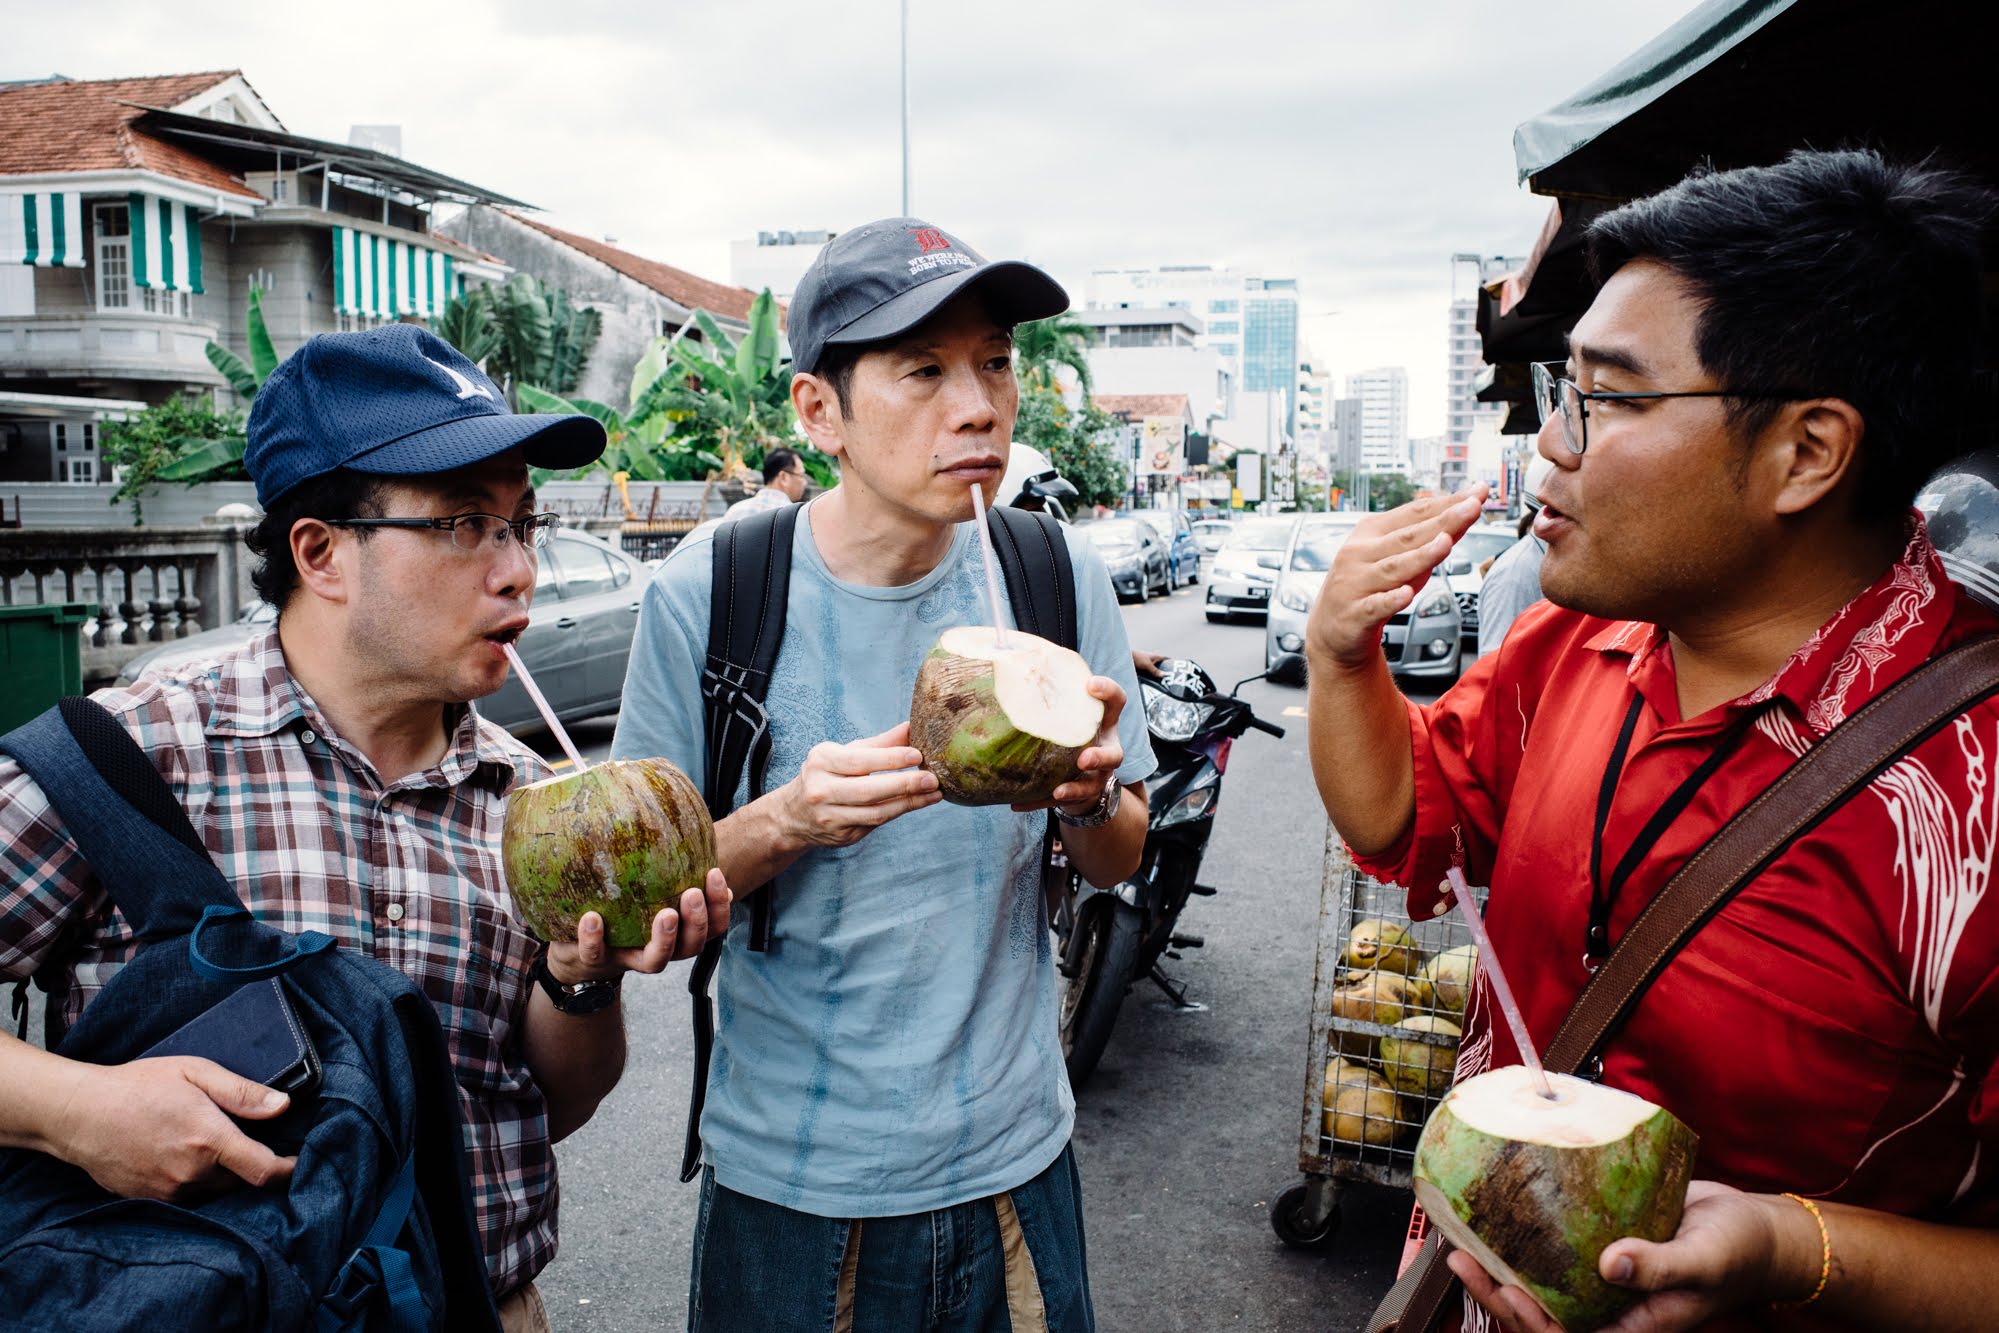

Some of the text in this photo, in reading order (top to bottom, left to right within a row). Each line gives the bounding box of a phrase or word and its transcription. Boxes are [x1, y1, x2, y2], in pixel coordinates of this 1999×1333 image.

[908, 256, 926, 267] WE
[909, 261, 938, 276] BORN
[1173, 660, 1202, 679] PJC
